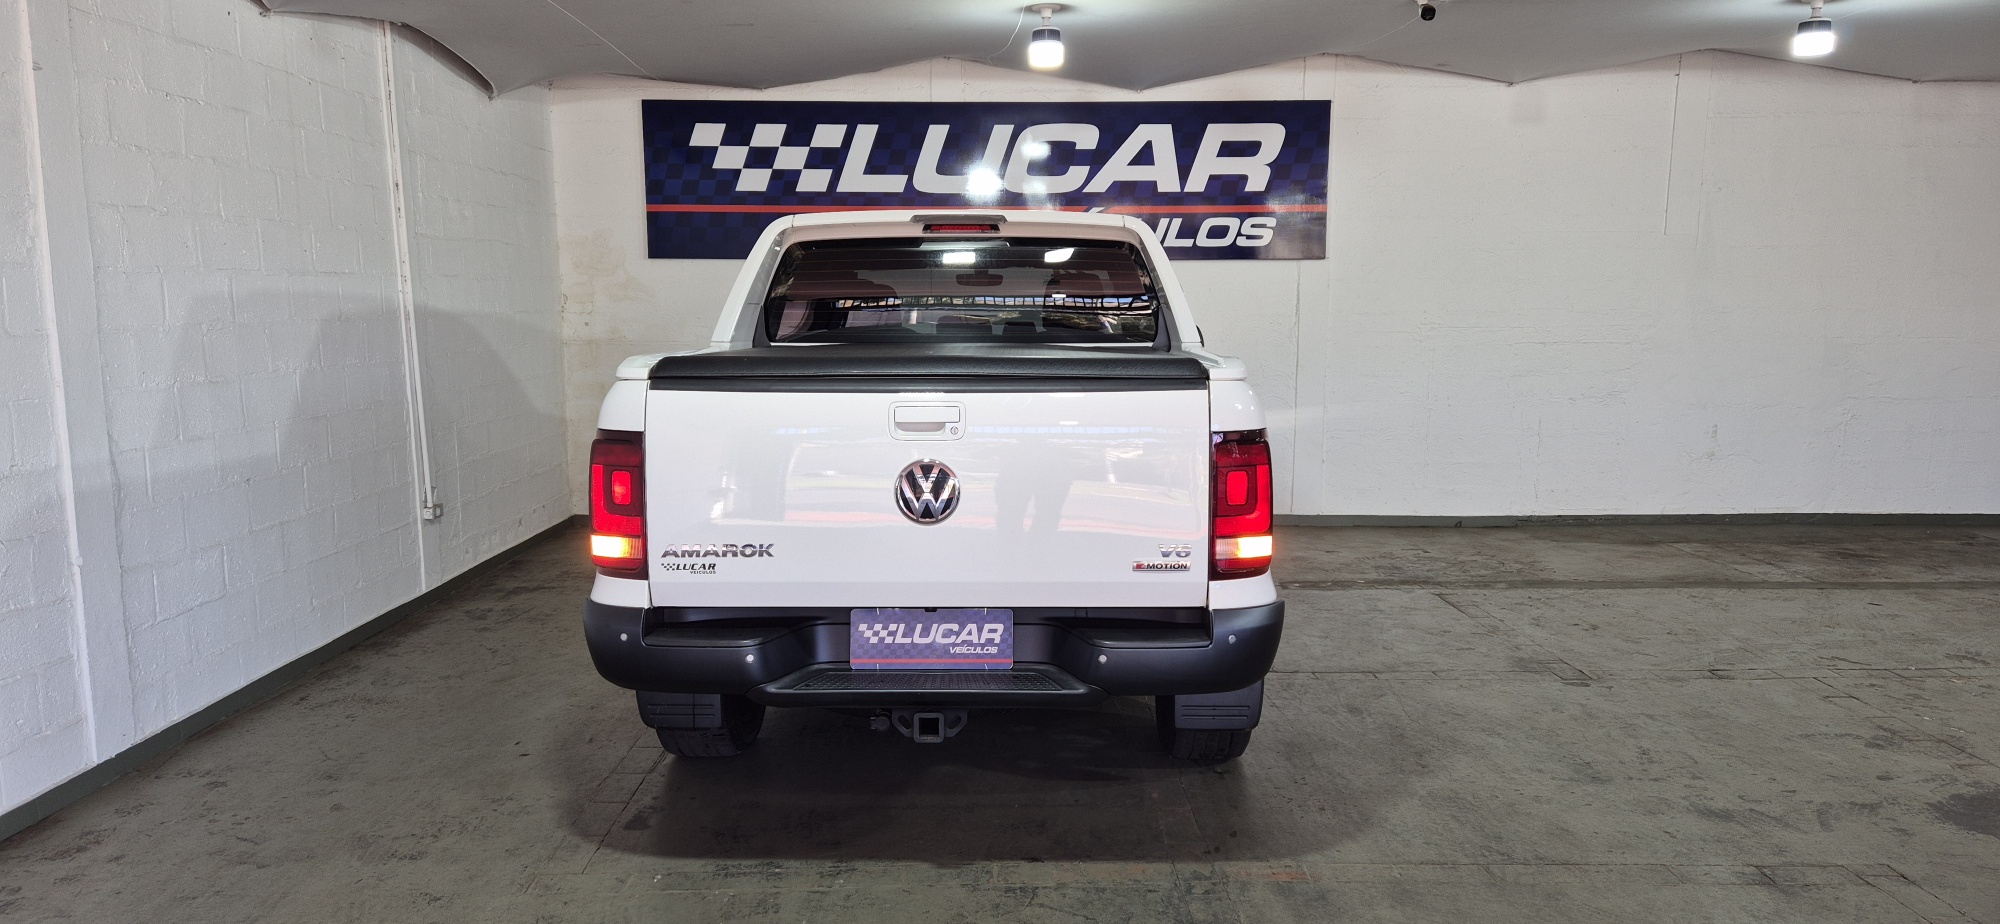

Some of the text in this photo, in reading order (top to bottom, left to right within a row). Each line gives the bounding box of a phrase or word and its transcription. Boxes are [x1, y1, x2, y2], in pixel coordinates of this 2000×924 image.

[835, 123, 1287, 194] LUCAR
[660, 543, 775, 558] AMAROK
[1158, 543, 1192, 558] V6
[676, 563, 717, 571] LUCAR
[894, 623, 1005, 644] LUCAR
[949, 645, 998, 654] VEÍCULOS
